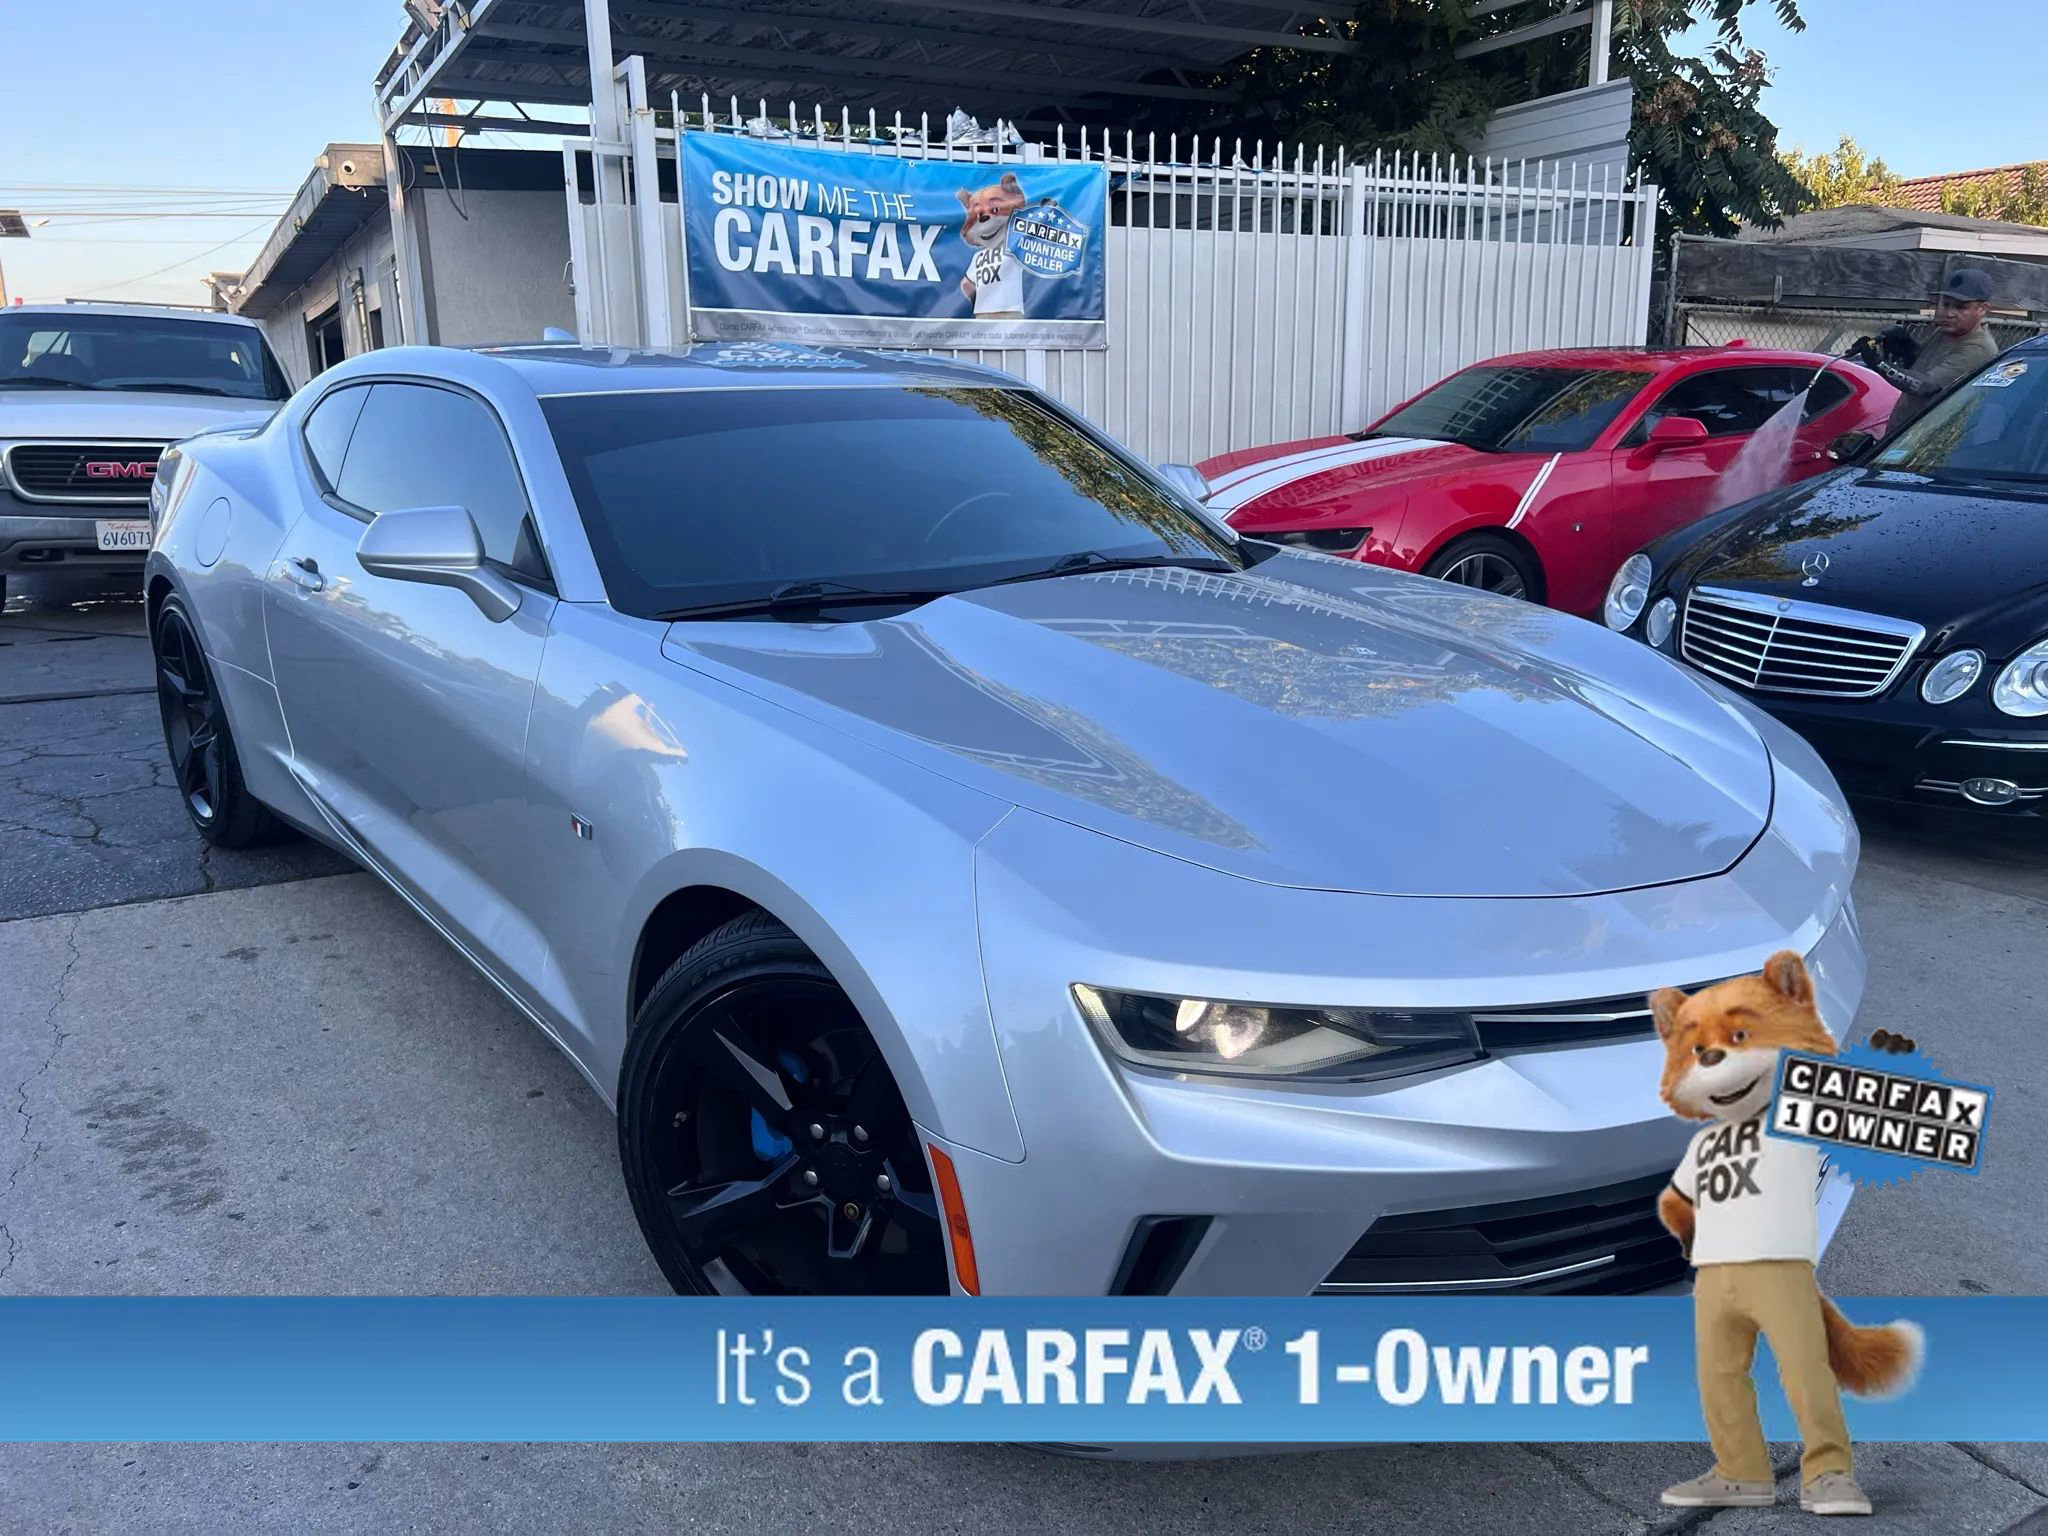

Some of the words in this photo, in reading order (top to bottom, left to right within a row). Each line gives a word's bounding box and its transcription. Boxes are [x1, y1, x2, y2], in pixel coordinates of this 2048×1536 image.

[712, 170, 809, 211] SHOW
[817, 183, 860, 217] ME
[864, 190, 917, 221] THE
[1015, 219, 1080, 249] CARFAX
[976, 248, 1002, 268] CAR
[1017, 238, 1075, 262] ADVANTAGE
[1024, 252, 1063, 273] DEALER
[976, 264, 1001, 288] FOX
[86, 461, 158, 478] GMC
